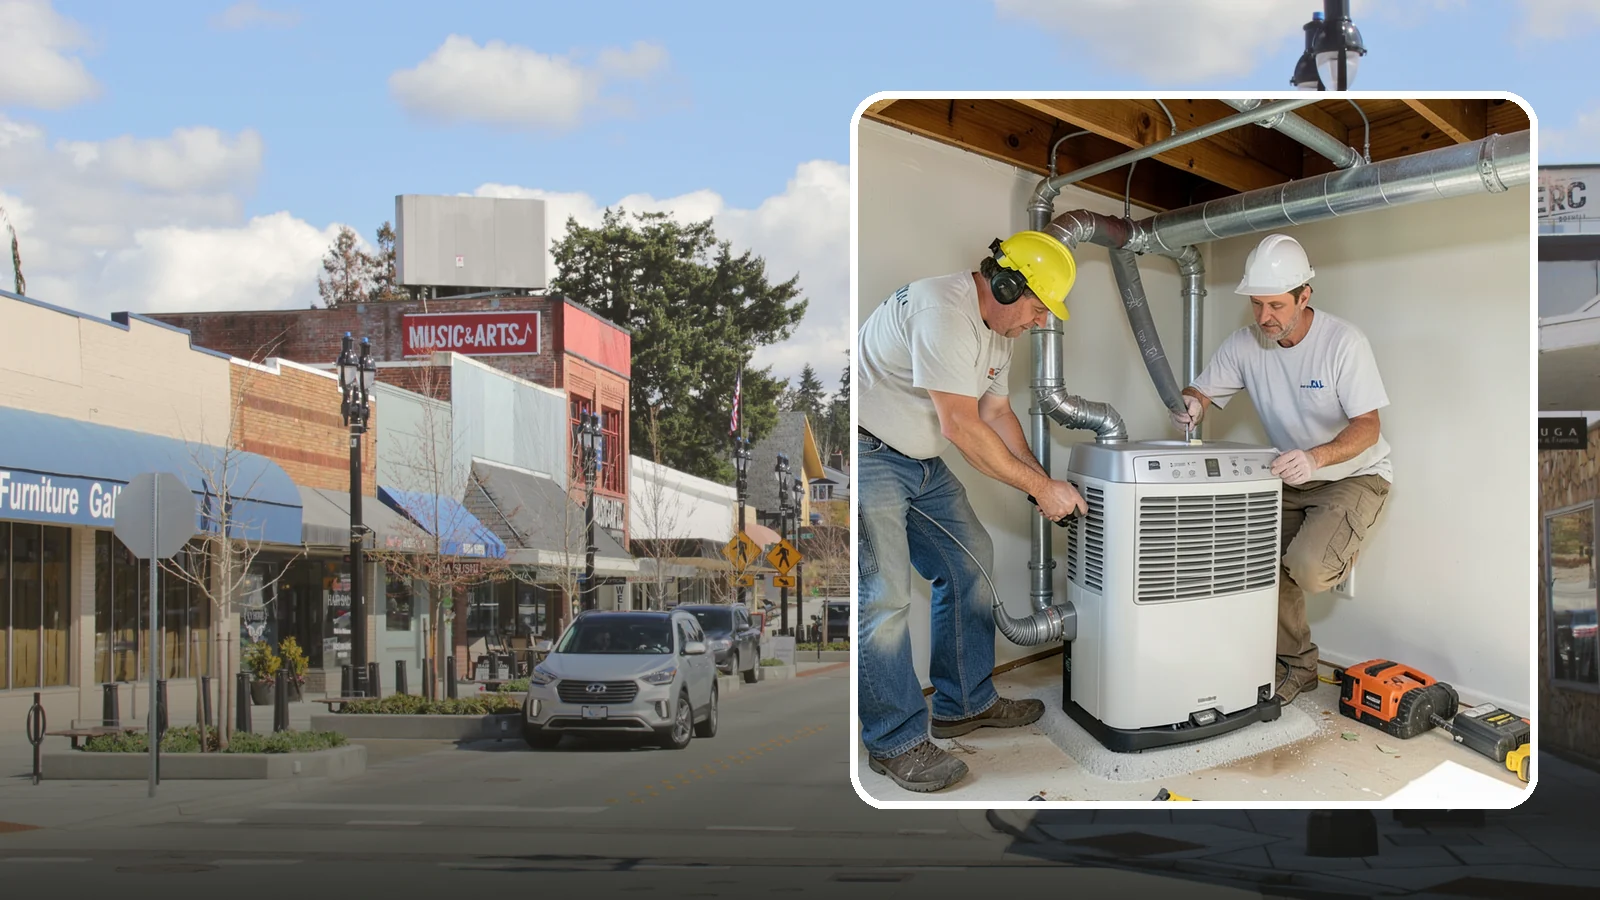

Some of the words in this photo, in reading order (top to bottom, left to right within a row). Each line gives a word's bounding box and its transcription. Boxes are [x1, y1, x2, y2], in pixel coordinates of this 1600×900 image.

[0, 471, 79, 515] Furniture
[90, 482, 122, 519] Gal
[453, 563, 479, 574] SUSHI
